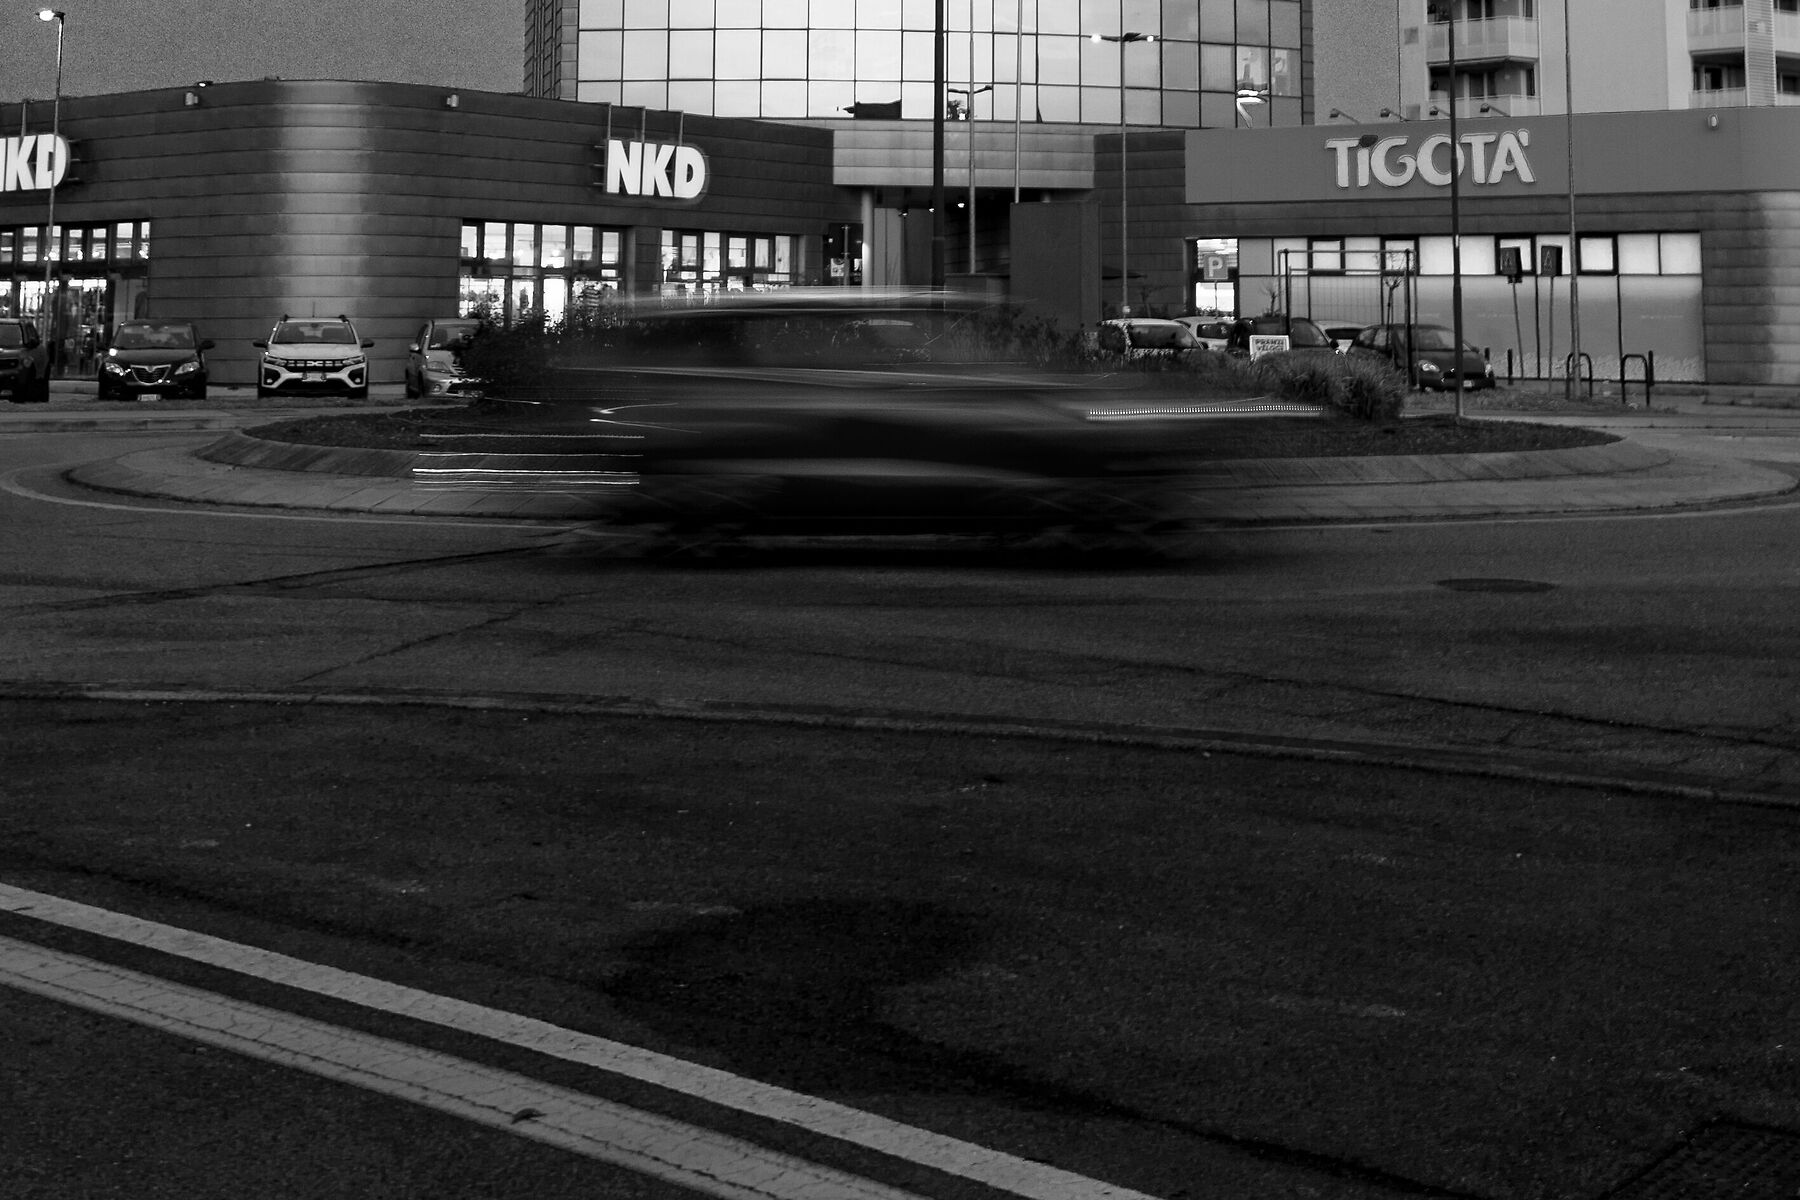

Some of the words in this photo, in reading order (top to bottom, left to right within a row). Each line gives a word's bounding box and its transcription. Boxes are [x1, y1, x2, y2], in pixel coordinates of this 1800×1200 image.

[0, 134, 67, 192] KD
[606, 140, 706, 199] NKD
[1208, 256, 1223, 277] P
